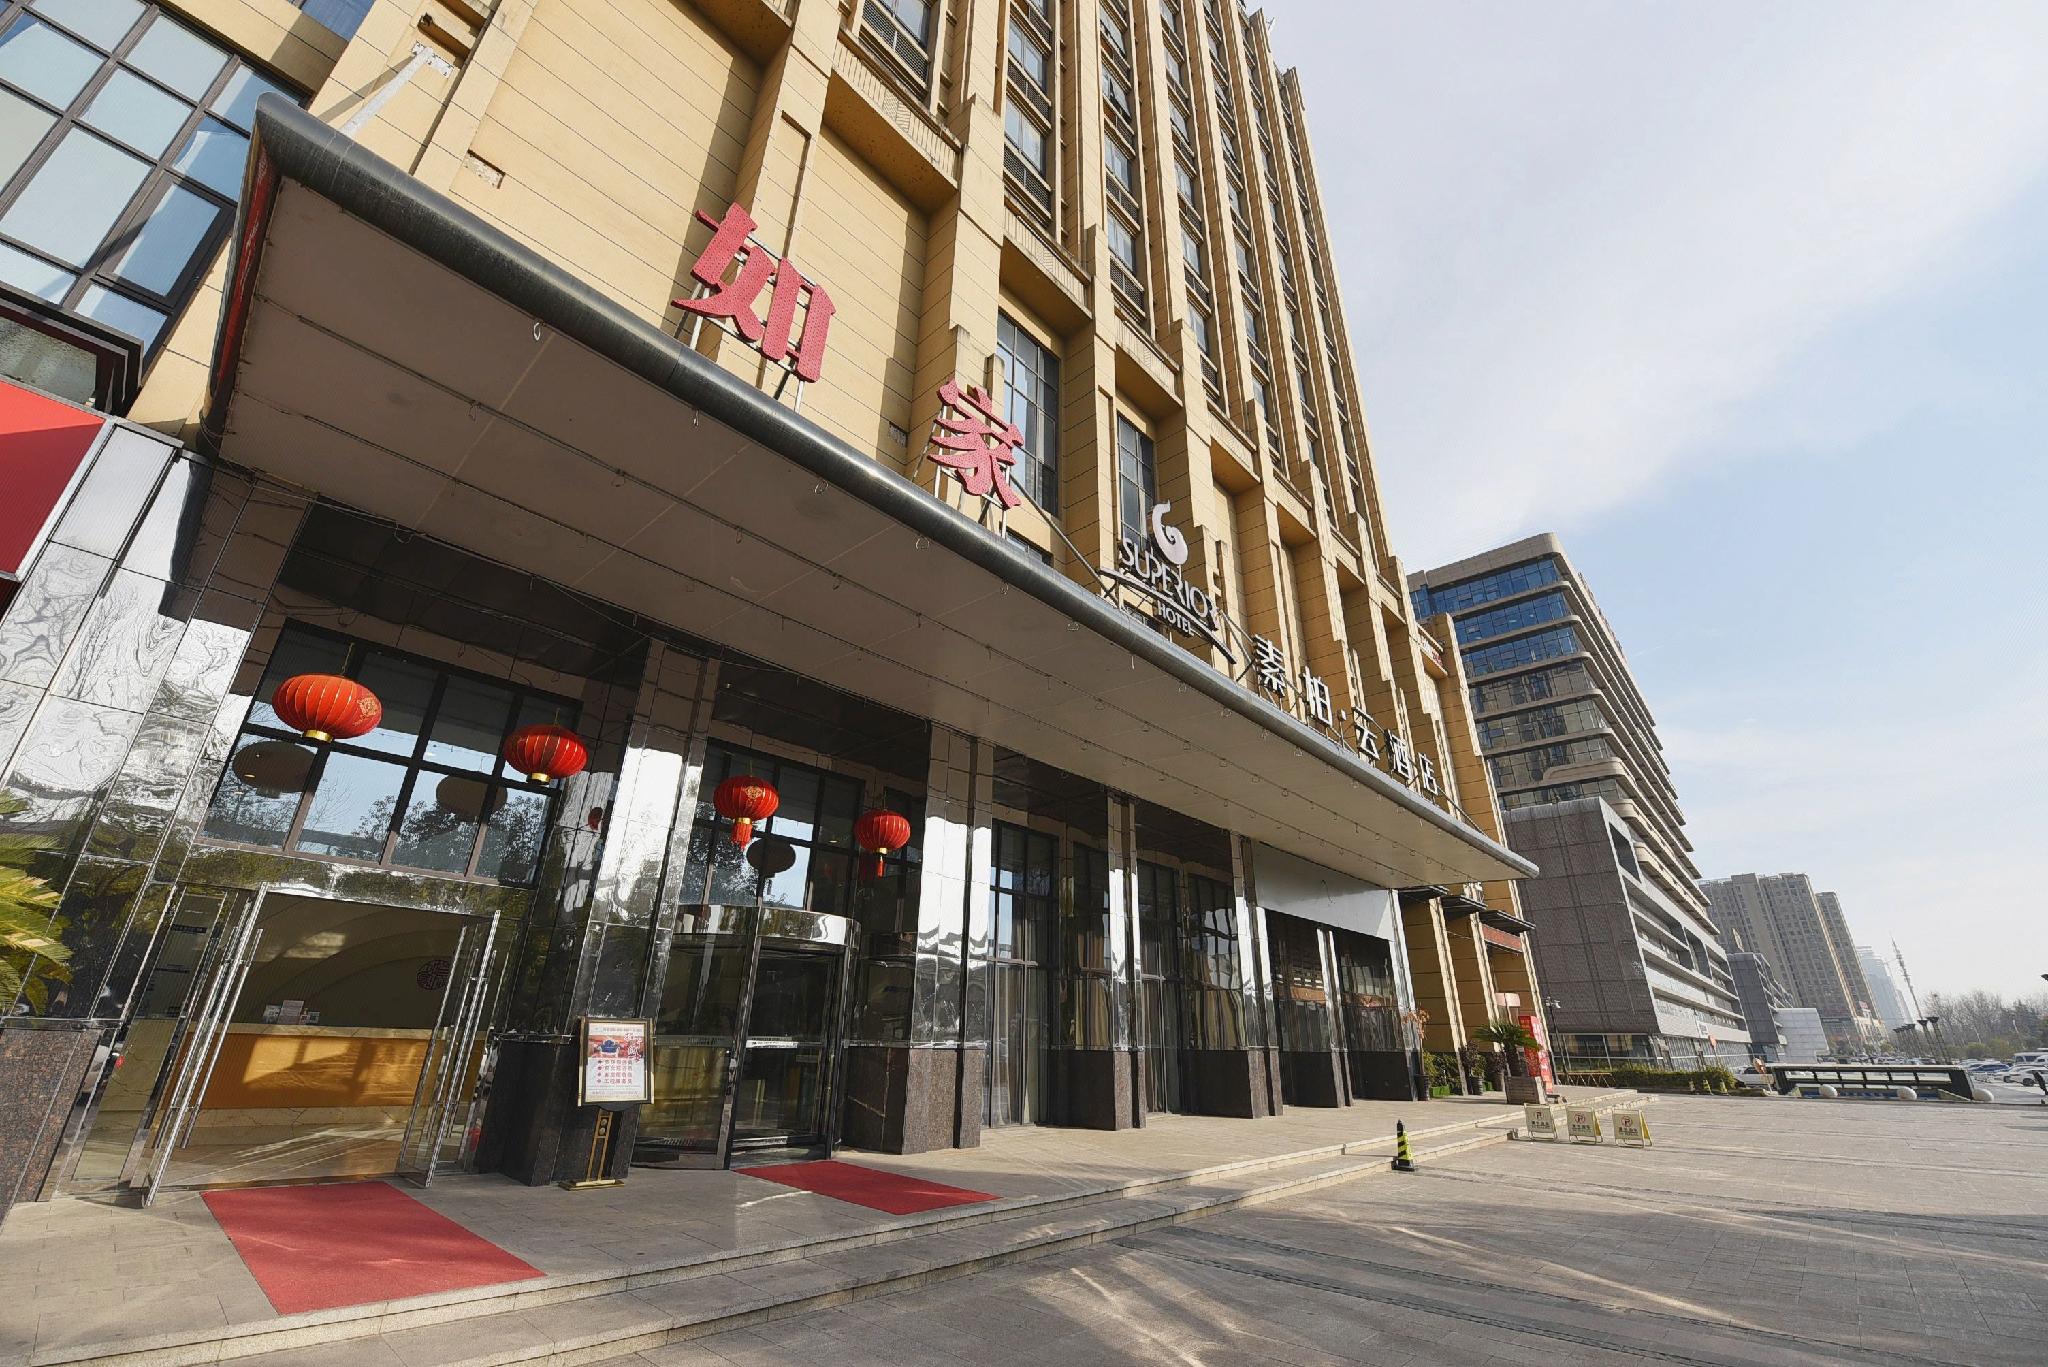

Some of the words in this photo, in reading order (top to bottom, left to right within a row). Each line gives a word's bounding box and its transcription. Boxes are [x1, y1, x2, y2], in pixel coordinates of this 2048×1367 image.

[671, 202, 1024, 510] 如家
[1119, 537, 1221, 631] SUPERIOR
[1157, 599, 1195, 637] HOTEL
